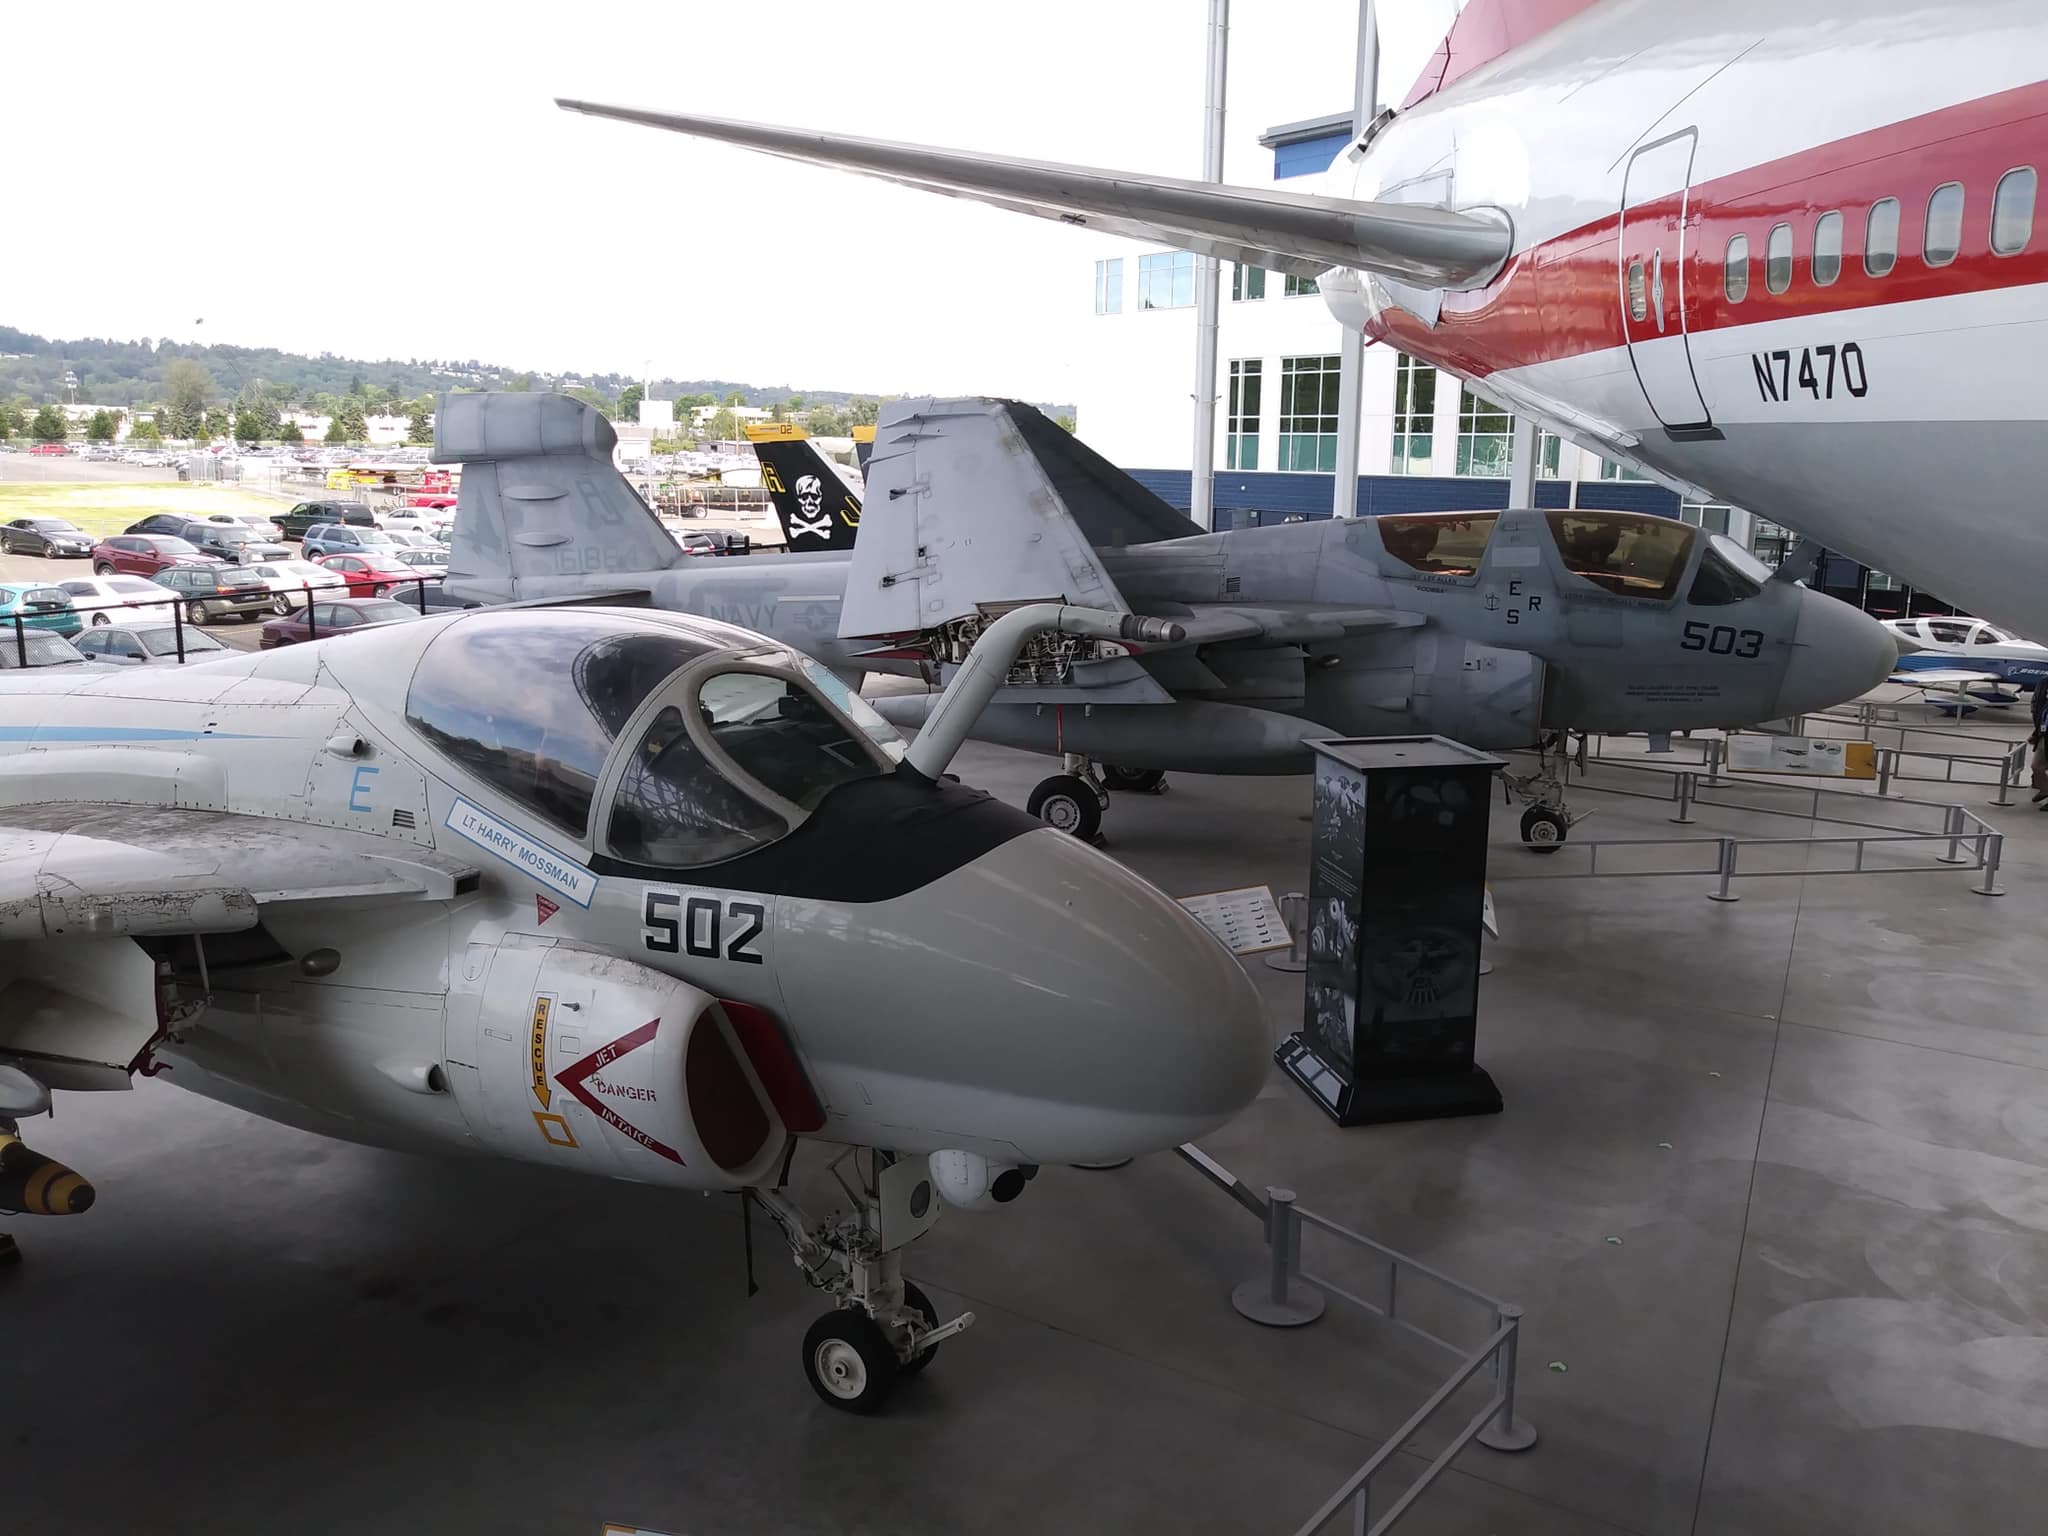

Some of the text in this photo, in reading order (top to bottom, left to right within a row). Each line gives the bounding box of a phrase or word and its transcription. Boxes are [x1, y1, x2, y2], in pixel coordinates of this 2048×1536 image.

[1752, 342, 1868, 402] N7470
[780, 424, 793, 435] 02
[1510, 580, 1522, 596] E
[1529, 596, 1542, 611] R
[709, 603, 777, 630] NAVY
[1507, 609, 1520, 624] S
[1680, 620, 1765, 659] 503
[349, 766, 380, 813] E
[462, 814, 580, 891] LT. HARRY MOSSMAN
[644, 891, 765, 965] 502
[534, 1003, 547, 1087] RESCUE
[595, 1044, 618, 1067] JET
[596, 1082, 657, 1102] DANGER
[601, 1107, 655, 1147] INTAKE
